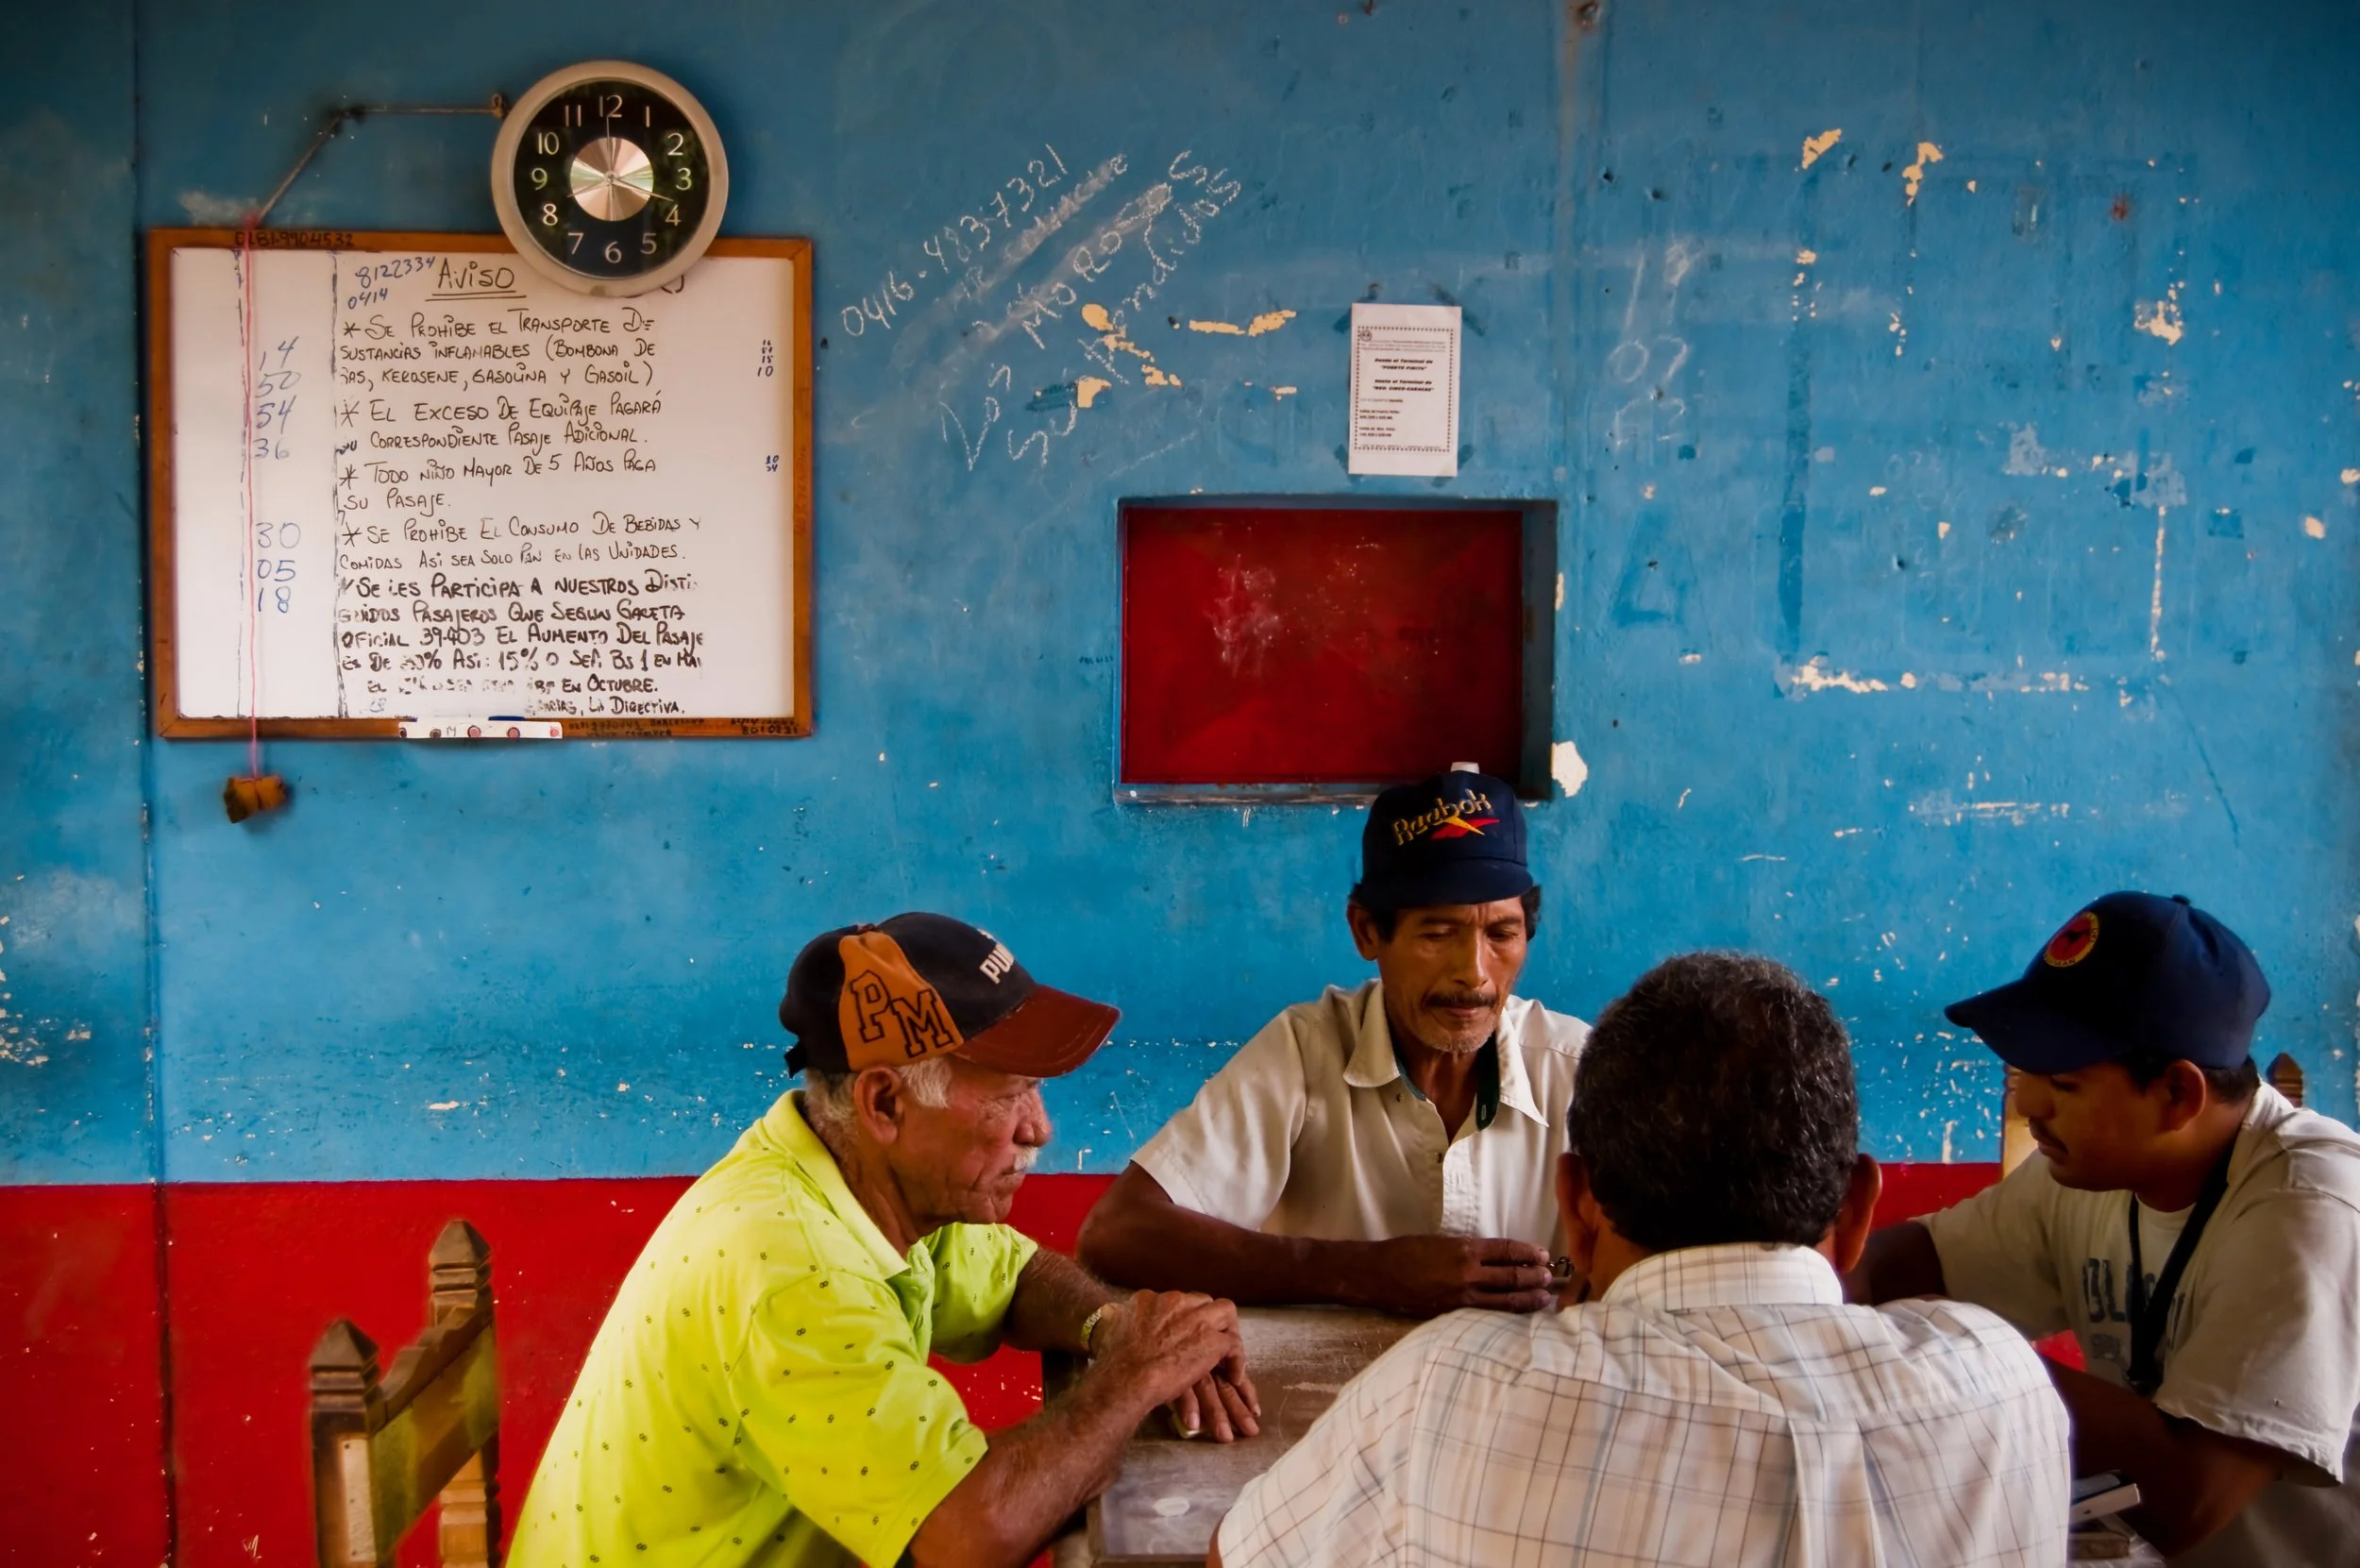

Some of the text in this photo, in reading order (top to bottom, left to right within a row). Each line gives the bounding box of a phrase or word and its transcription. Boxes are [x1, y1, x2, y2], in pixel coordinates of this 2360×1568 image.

[565, 104, 582, 127] 11
[598, 94, 623, 118] 12
[537, 131, 560, 156] 10
[666, 132, 683, 156] 2
[531, 167, 548, 191] 9
[676, 167, 692, 191] 3
[542, 203, 558, 227] 8
[665, 204, 682, 227] 4
[567, 232, 584, 255] 7
[604, 241, 622, 263] 6
[640, 232, 657, 255] 5
[348, 288, 388, 310] 0414
[488, 322, 508, 336] EL
[757, 365, 774, 378] 10
[255, 395, 297, 434] 54
[548, 453, 563, 471] 5
[256, 522, 301, 548] 30
[258, 559, 295, 582] 05
[258, 585, 291, 614] 18
